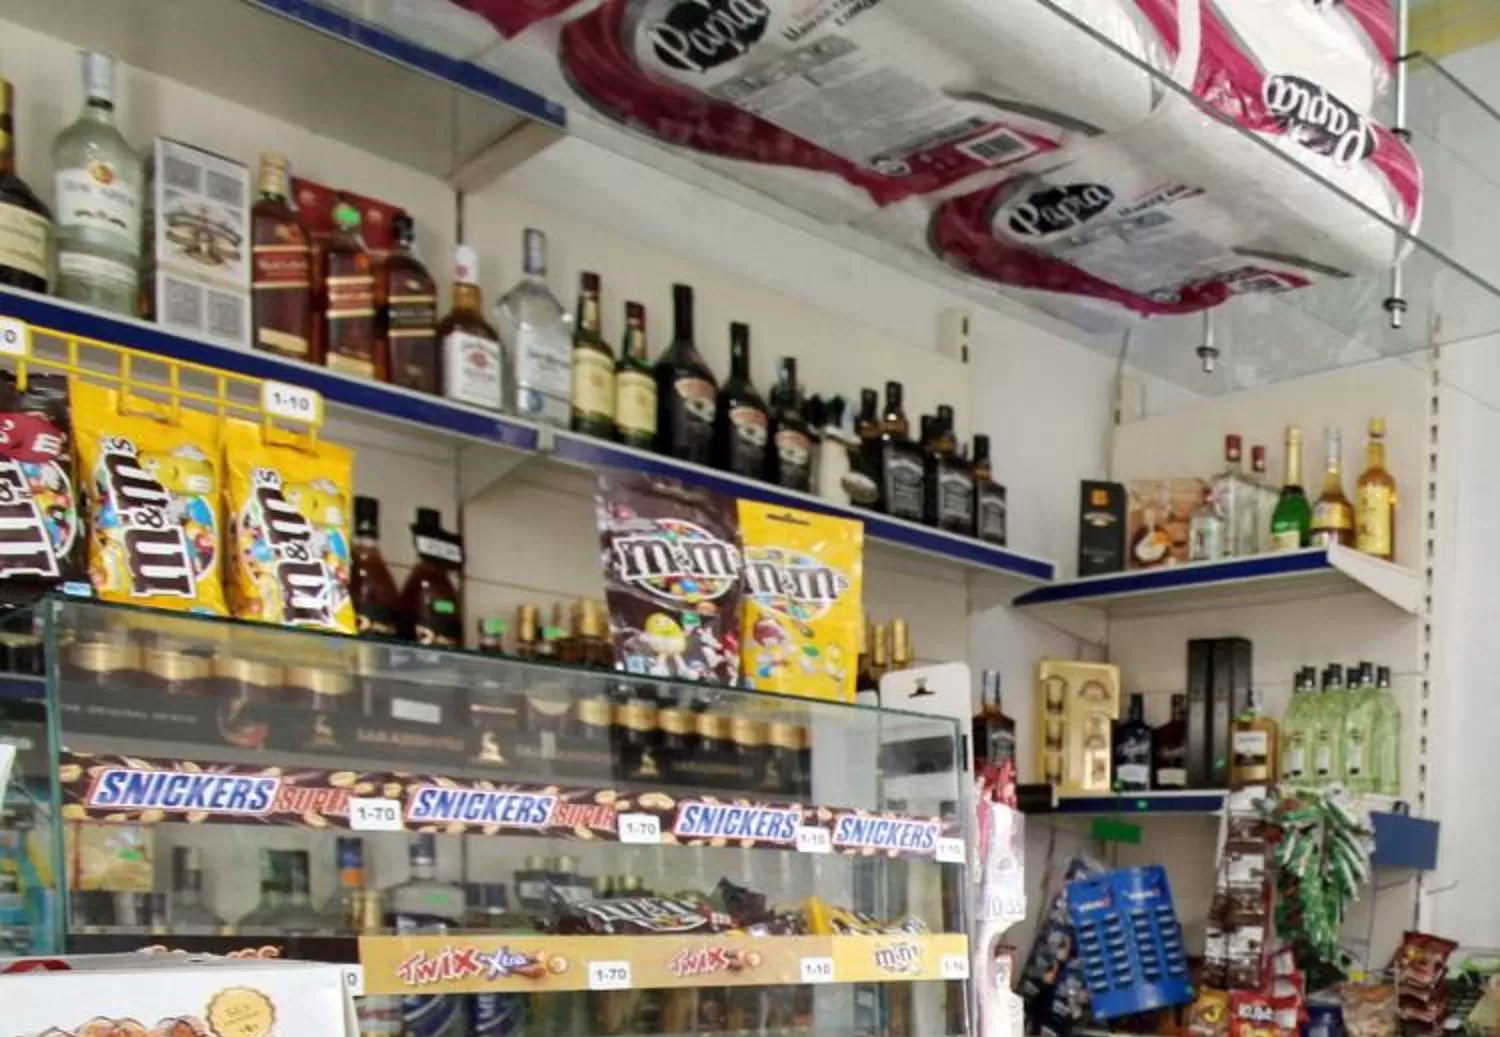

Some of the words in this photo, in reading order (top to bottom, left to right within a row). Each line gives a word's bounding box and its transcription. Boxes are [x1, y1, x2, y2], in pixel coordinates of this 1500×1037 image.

[1006, 183, 1115, 237] Papia
[272, 391, 311, 412] 1-10
[95, 770, 276, 813] SNICKERS
[412, 788, 550, 825] SNICKERS
[358, 806, 397, 822] 1-70
[626, 822, 657, 835] 1-70
[680, 804, 800, 840] SNICKERS
[836, 817, 938, 849] SNICKERS
[398, 946, 481, 985] TWIX
[595, 968, 627, 982] 1-70
